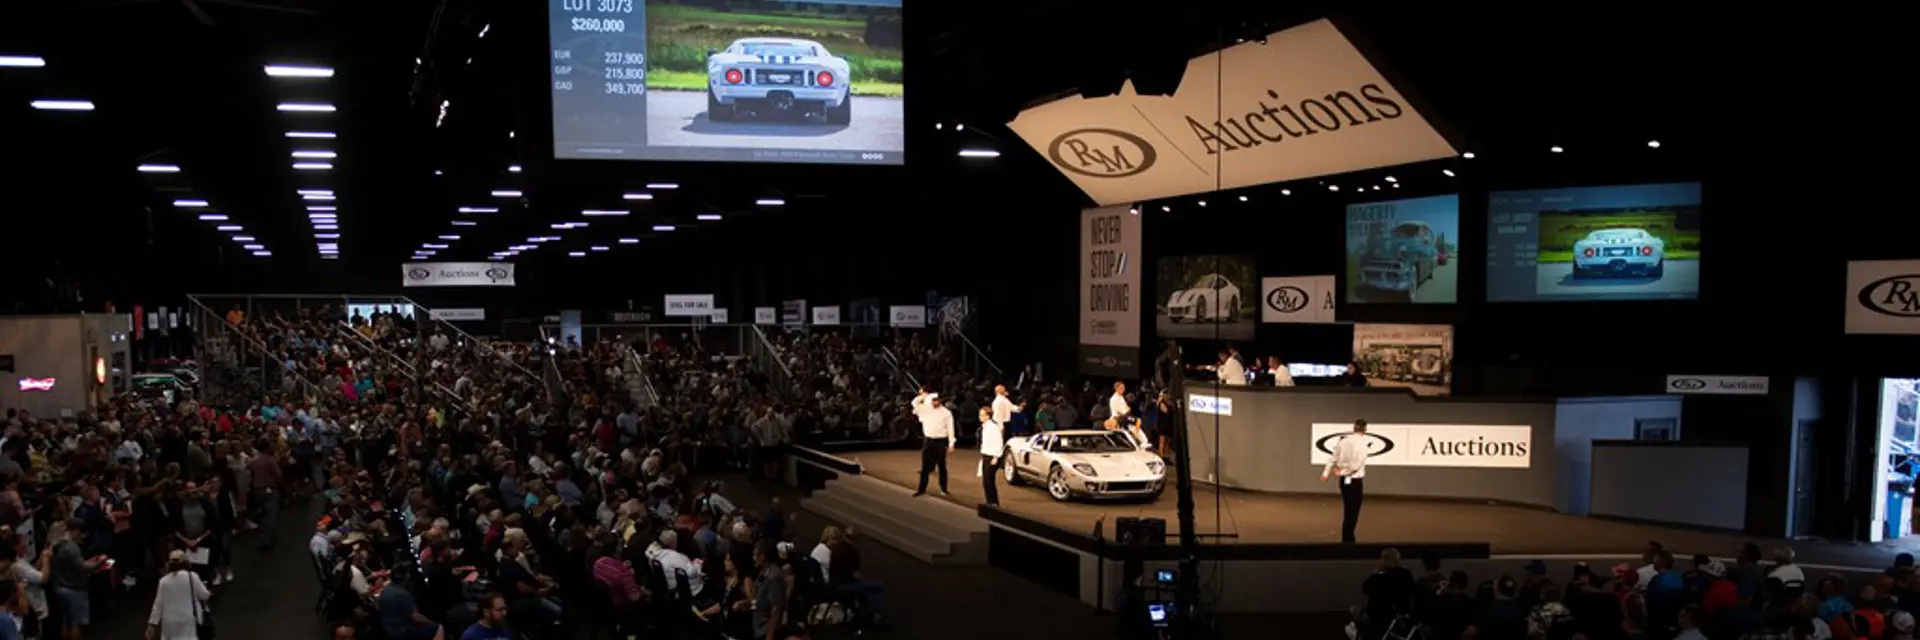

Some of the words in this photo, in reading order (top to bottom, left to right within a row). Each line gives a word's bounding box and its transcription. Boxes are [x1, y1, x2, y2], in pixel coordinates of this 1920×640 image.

[564, 0, 591, 12] LOT
[598, 0, 633, 13] 3073
[571, 18, 625, 33] $260,000
[554, 50, 571, 60] EUR
[604, 51, 644, 65] 237,900
[604, 67, 644, 80] 215,800
[604, 82, 644, 95] 349,700
[1065, 138, 1135, 173] RM
[1185, 84, 1402, 154] Auctions
[1090, 215, 1122, 246] NEVER
[1090, 283, 1129, 312] DRIVING
[1422, 436, 1527, 458] Auctions
